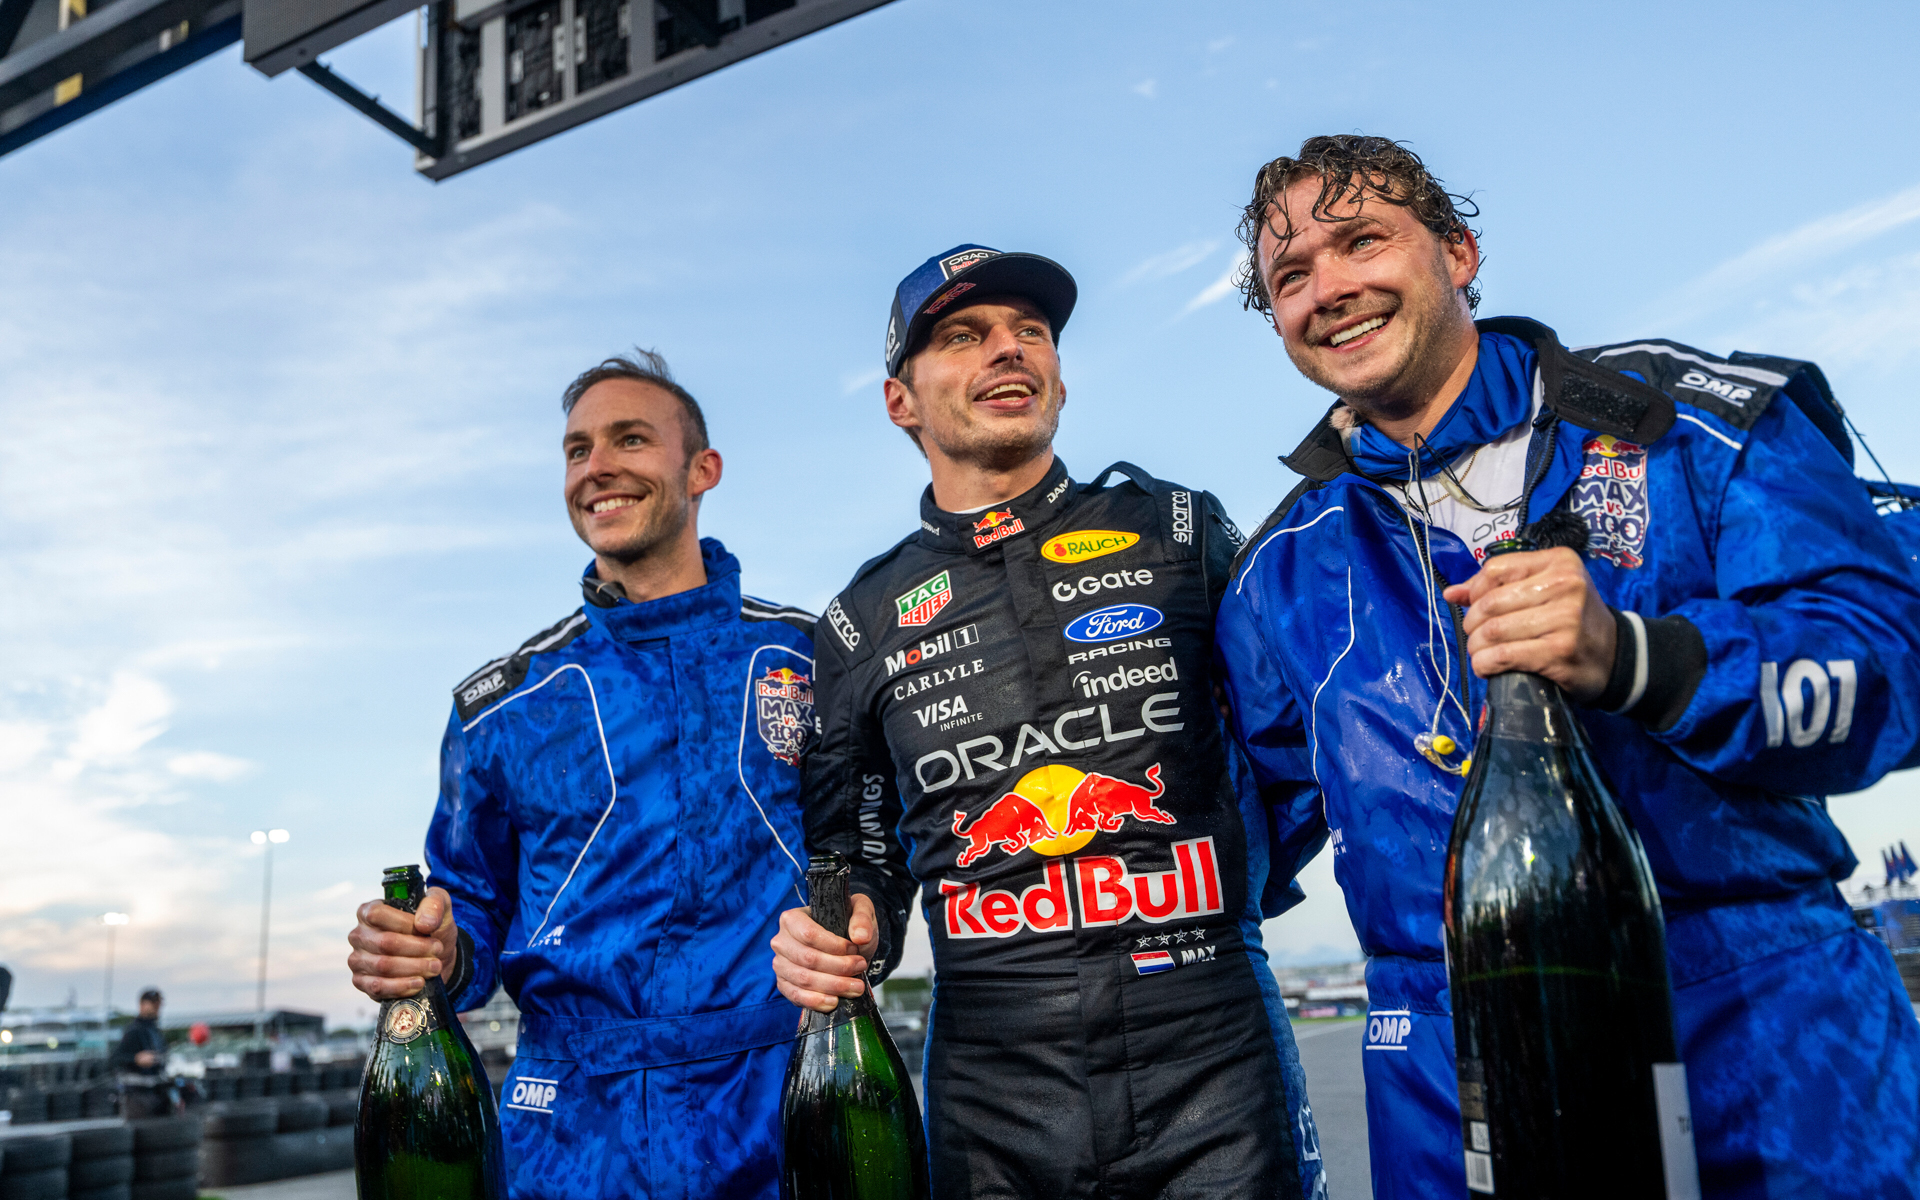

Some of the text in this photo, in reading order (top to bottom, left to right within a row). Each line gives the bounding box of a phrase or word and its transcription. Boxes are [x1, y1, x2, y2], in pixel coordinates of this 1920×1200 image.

[949, 252, 995, 266] ORACL
[1681, 372, 1753, 401] OMP
[1580, 455, 1647, 480] ed Bul
[1046, 477, 1070, 503] DAM
[1570, 478, 1646, 513] MAX
[1172, 491, 1192, 545] sparco
[1603, 499, 1626, 517] VS
[973, 517, 1025, 549] Red Bull
[1067, 536, 1128, 555] RAUCH
[902, 576, 946, 610] TAG
[1078, 569, 1153, 595] Gate
[902, 592, 949, 624] HEUER
[827, 597, 861, 652] sparco
[1085, 609, 1145, 638] Ford
[884, 632, 952, 677] Mobil
[1068, 637, 1172, 665] RACING
[463, 673, 504, 702] OMP
[894, 659, 985, 701] CARLYLE
[1073, 657, 1179, 699] indeed
[759, 682, 814, 705] Red Bull
[1760, 658, 1858, 748] 101
[761, 698, 814, 727] MAX
[782, 715, 797, 727] VS
[912, 694, 969, 728] VISA
[940, 712, 983, 732] INFINITE
[768, 721, 807, 749] 100
[914, 691, 1185, 794] ORACLE
[939, 857, 1072, 939] Red
[1074, 836, 1224, 928] Bull
[1181, 945, 1216, 966] MAX
[1368, 1016, 1411, 1045] OMP
[512, 1081, 557, 1108] OMP
